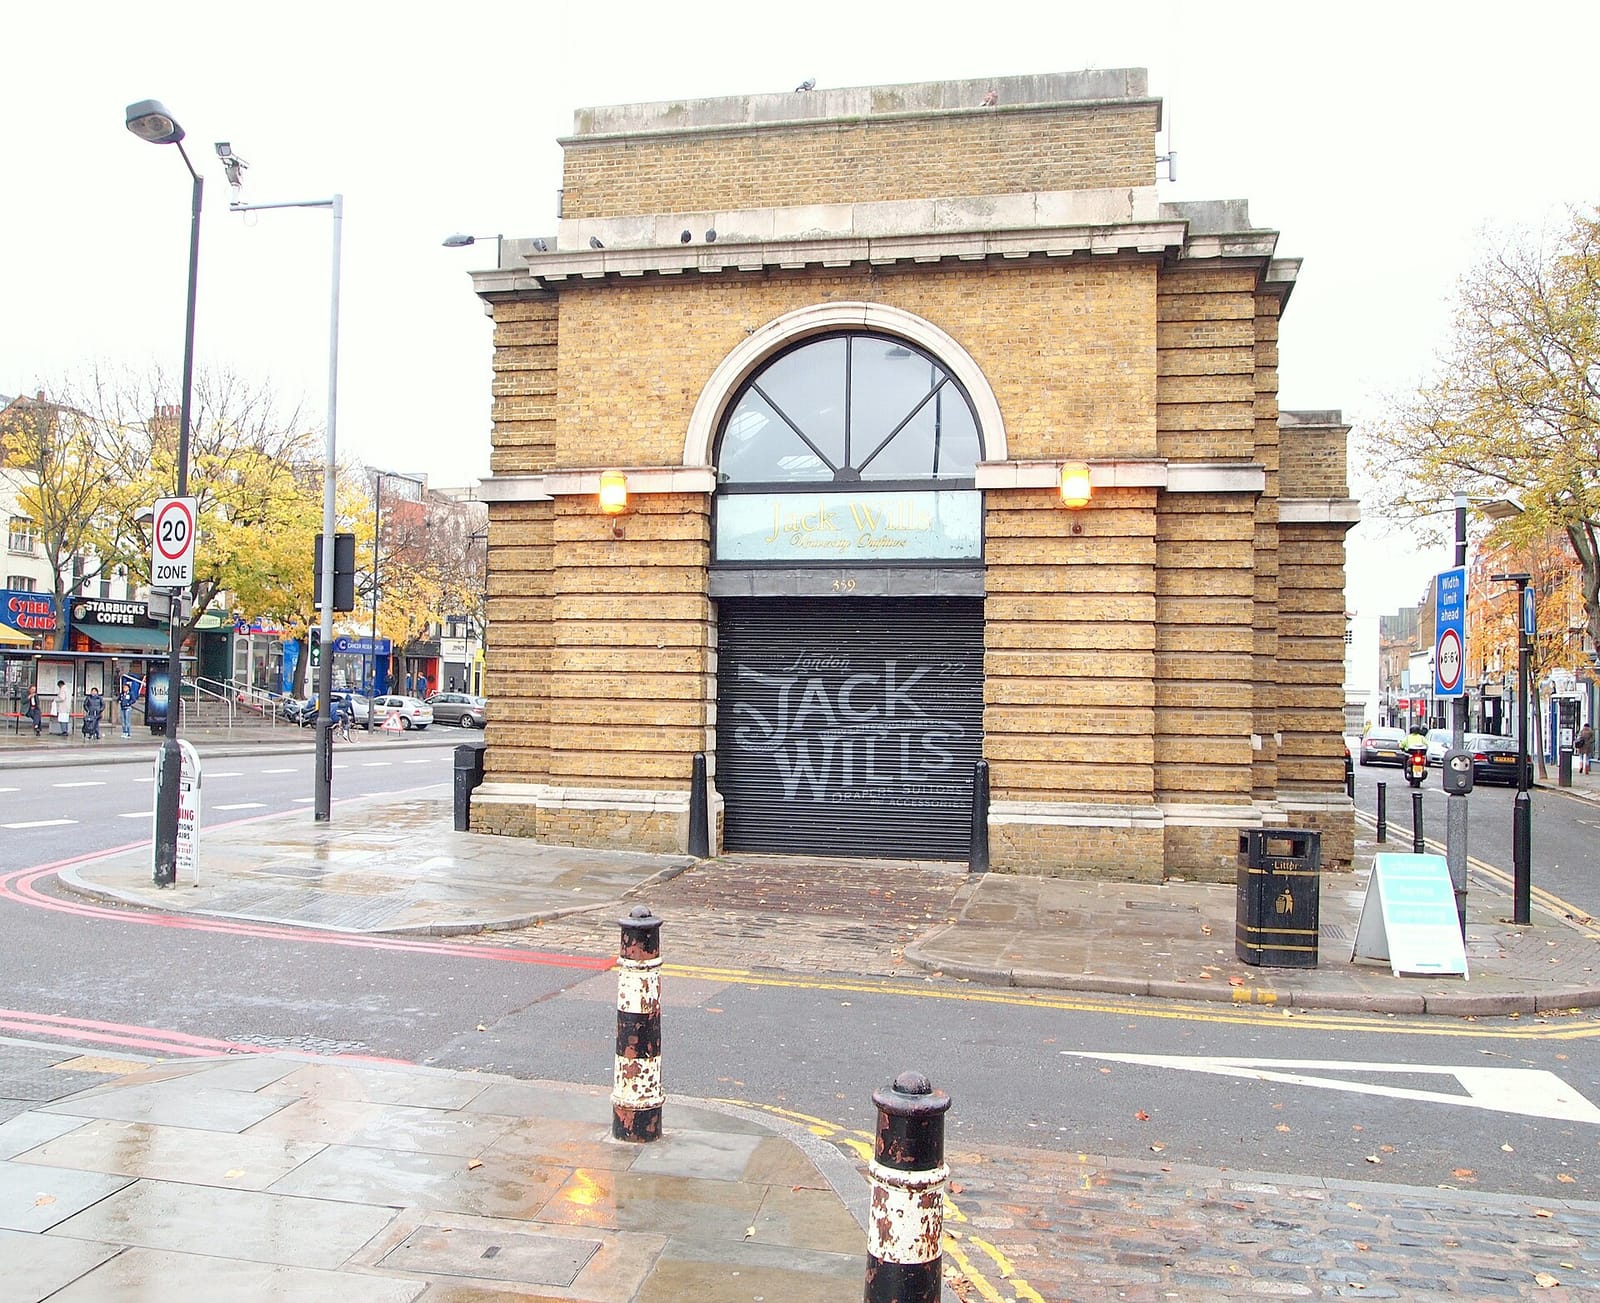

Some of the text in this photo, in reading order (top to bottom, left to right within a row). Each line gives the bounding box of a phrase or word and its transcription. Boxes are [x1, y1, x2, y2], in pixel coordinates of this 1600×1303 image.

[765, 500, 932, 543] Jack Wills
[162, 520, 186, 542] 20
[157, 565, 187, 579] ZONE
[832, 579, 856, 592] 359
[1441, 575, 1460, 590] Width
[8, 596, 50, 614] CYBER
[85, 601, 145, 615] STARBUCKS
[97, 612, 135, 625] COFFEE
[1441, 607, 1459, 622] ahead
[782, 649, 851, 674] London
[733, 660, 935, 751] JACK
[773, 729, 955, 801] WILLS
[889, 797, 967, 809] ACCESSORIES
